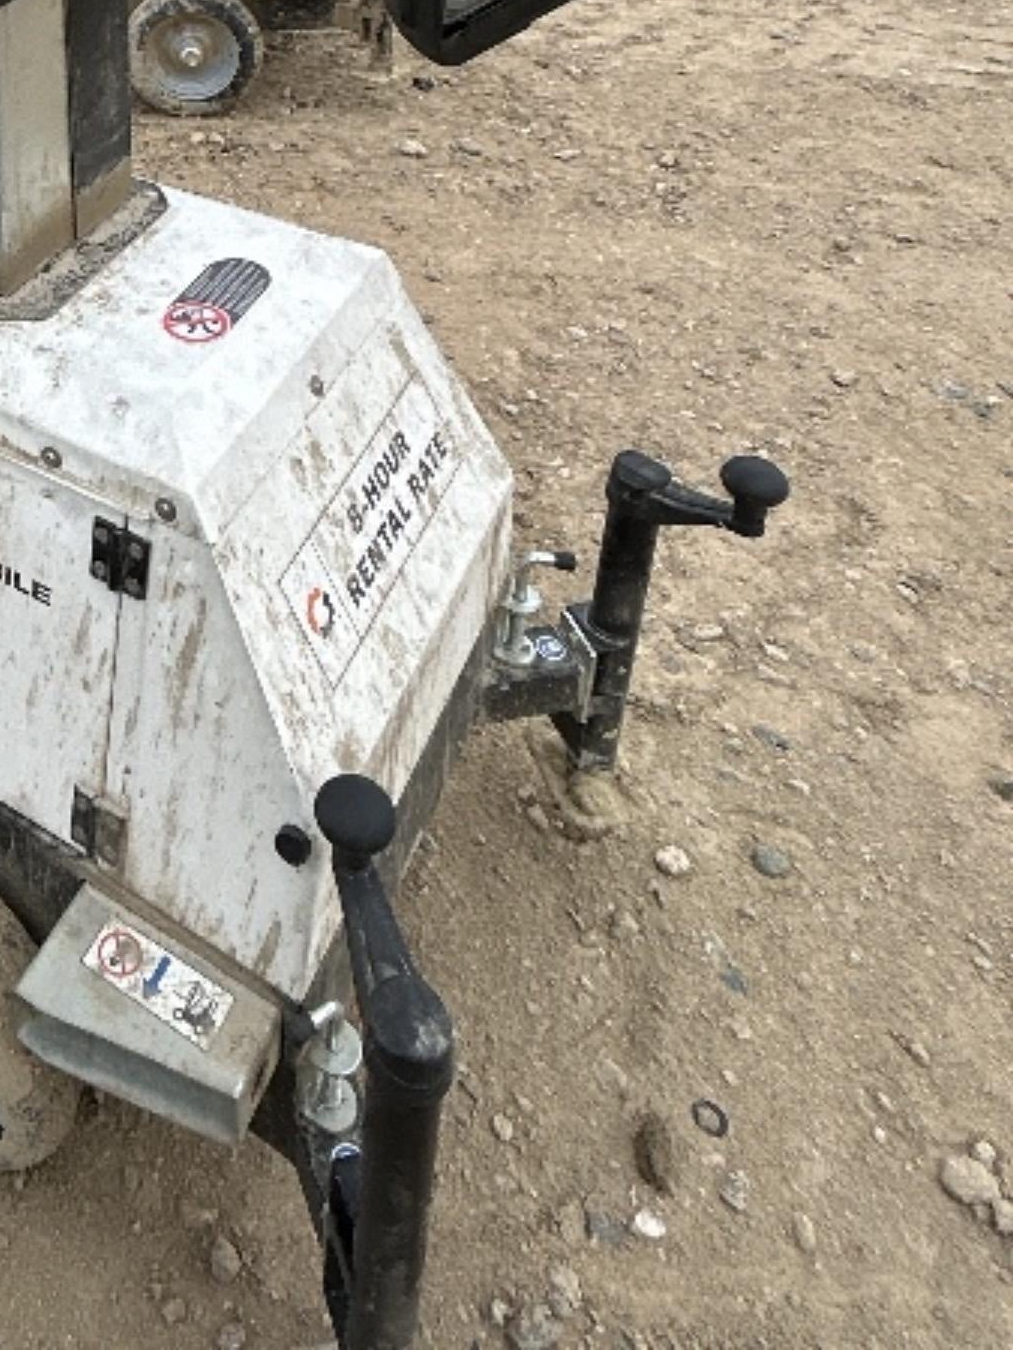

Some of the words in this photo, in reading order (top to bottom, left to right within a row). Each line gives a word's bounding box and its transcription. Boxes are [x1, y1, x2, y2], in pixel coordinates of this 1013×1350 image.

[346, 430, 412, 534] 8-HOUR
[346, 498, 413, 608] RENTAL
[406, 431, 449, 503] RATE
